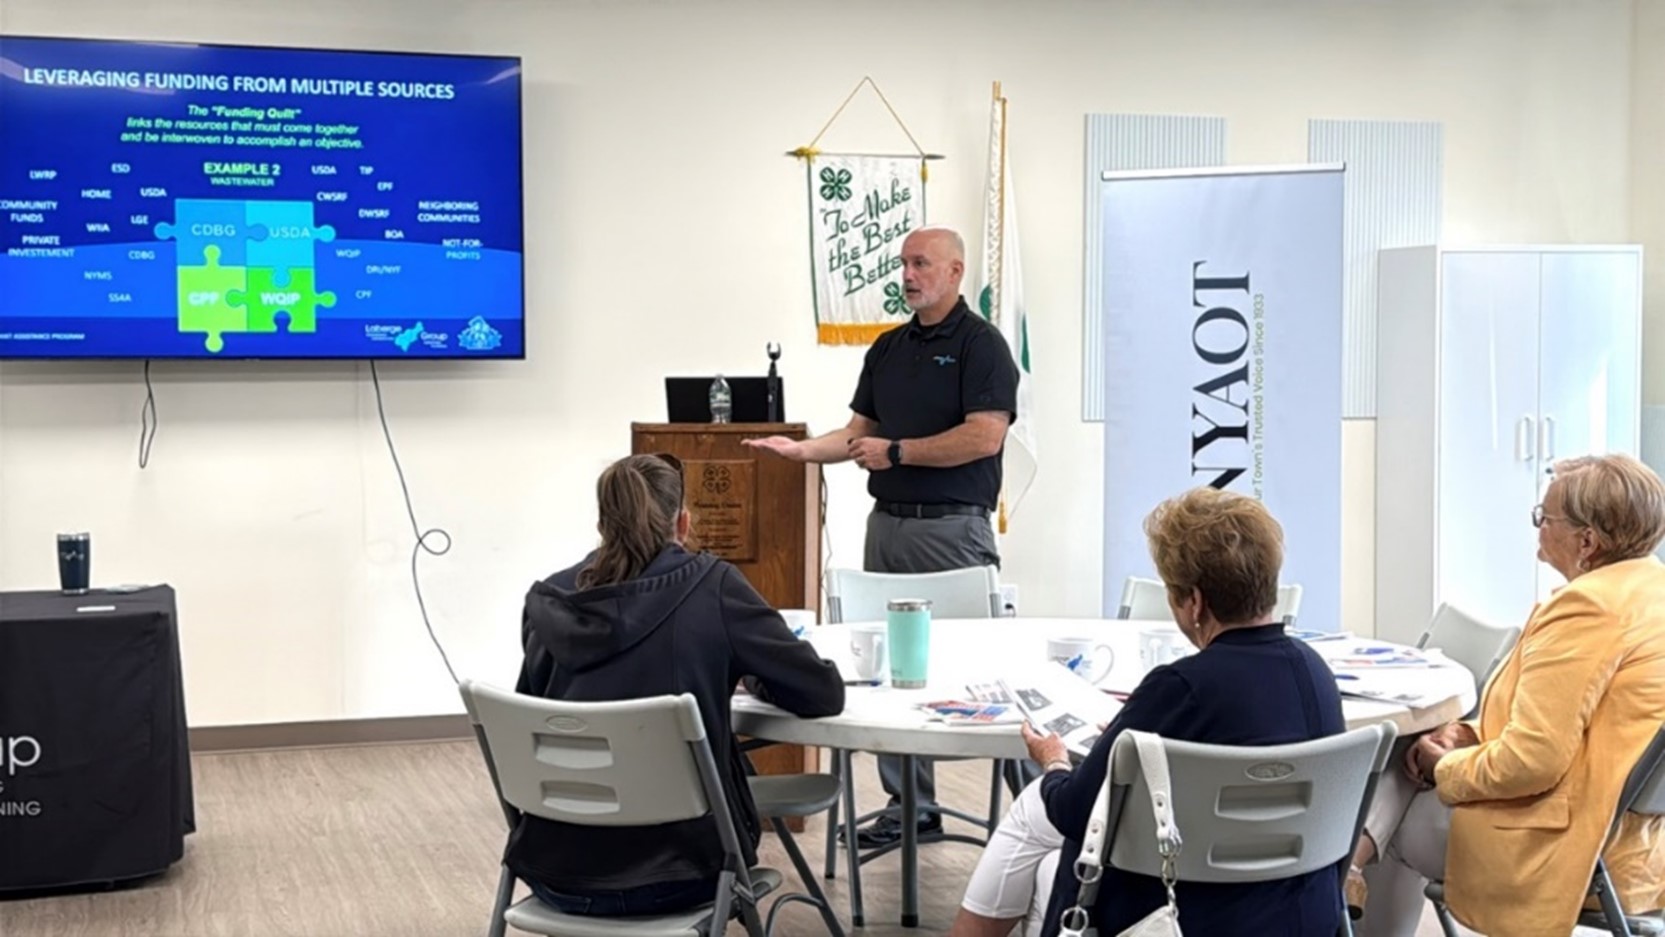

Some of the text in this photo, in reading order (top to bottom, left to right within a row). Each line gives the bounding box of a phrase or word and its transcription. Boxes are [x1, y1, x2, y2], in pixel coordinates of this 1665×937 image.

[24, 68, 455, 100] LEVERAGING FUNDING FROM MULTIPLE SOURCES
[188, 104, 209, 116] The
[127, 117, 359, 137] links the resources that must come together
[121, 131, 143, 142] and
[145, 131, 159, 142] be
[162, 131, 221, 144] interwoven
[224, 133, 234, 145] to
[237, 135, 297, 148] accomplish
[298, 138, 313, 147] an
[203, 161, 281, 177] EXAMPLE 2
[311, 165, 337, 175] USDA
[359, 165, 374, 176] TIP
[29, 170, 57, 180] LWRP
[210, 176, 275, 187] WASTEWATER
[376, 181, 393, 191] EPF
[81, 189, 112, 200] HOME
[140, 187, 167, 198] USDA
[316, 191, 348, 202] CWSRF
[0, 200, 58, 210] OMMUNITY
[418, 201, 479, 212] NEIGHBORING
[852, 178, 911, 228] Make
[10, 212, 44, 223] FUNDS
[358, 208, 390, 218] DWSRF
[417, 212, 481, 224] COMMUNITIES
[130, 214, 149, 225] LGE
[191, 224, 236, 237] CDBG
[269, 225, 312, 239] USDA
[384, 229, 404, 239] BOA
[22, 235, 61, 246] PRIVATE
[442, 238, 484, 249] NOT-FOR-
[829, 212, 911, 273] the Best
[128, 250, 156, 260] CDBG
[335, 248, 361, 259] WQIP
[445, 250, 481, 261] PROFITS
[83, 271, 113, 281] NYMS
[843, 253, 903, 297] Bette
[108, 292, 132, 303] SS4A
[187, 291, 220, 306] CPF
[260, 291, 301, 307] WQIP
[355, 289, 372, 300] CPF
[1253, 293, 1264, 320] 1933
[420, 331, 448, 342] Group
[1252, 322, 1264, 355] Since
[1252, 358, 1264, 393] Voice
[1252, 395, 1263, 441] Trusted
[1252, 442, 1263, 485] Town's
